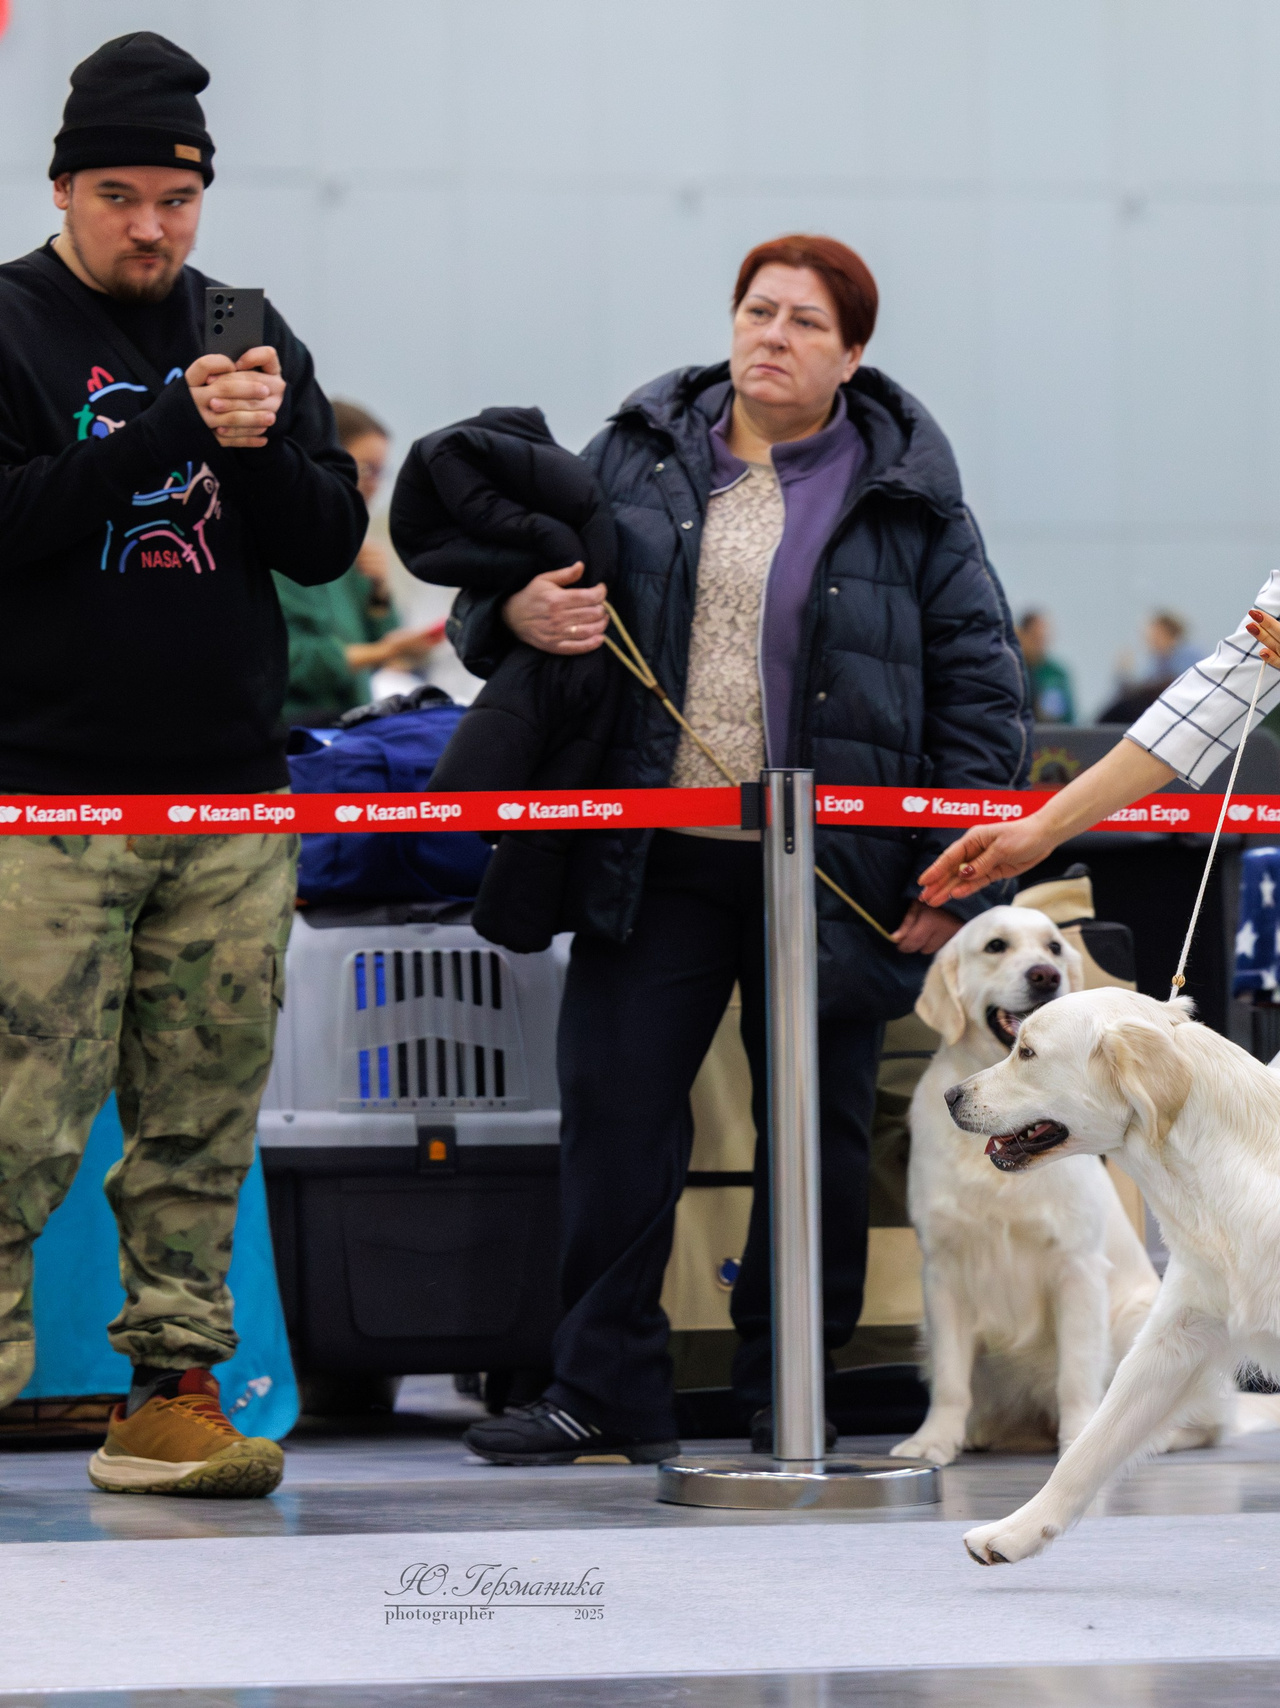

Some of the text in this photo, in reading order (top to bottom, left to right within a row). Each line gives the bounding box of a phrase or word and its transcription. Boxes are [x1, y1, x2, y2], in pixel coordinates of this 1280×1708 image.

[141, 551, 182, 568] NASA
[26, 804, 123, 826] Kazan Expo
[200, 803, 296, 825] Kazan Expo
[367, 801, 462, 823] Kazan Expo
[529, 799, 624, 821] Kazan Expo
[824, 795, 864, 814] Expo
[931, 797, 1023, 818] Kazan Expo
[1103, 804, 1190, 826] azan Expo
